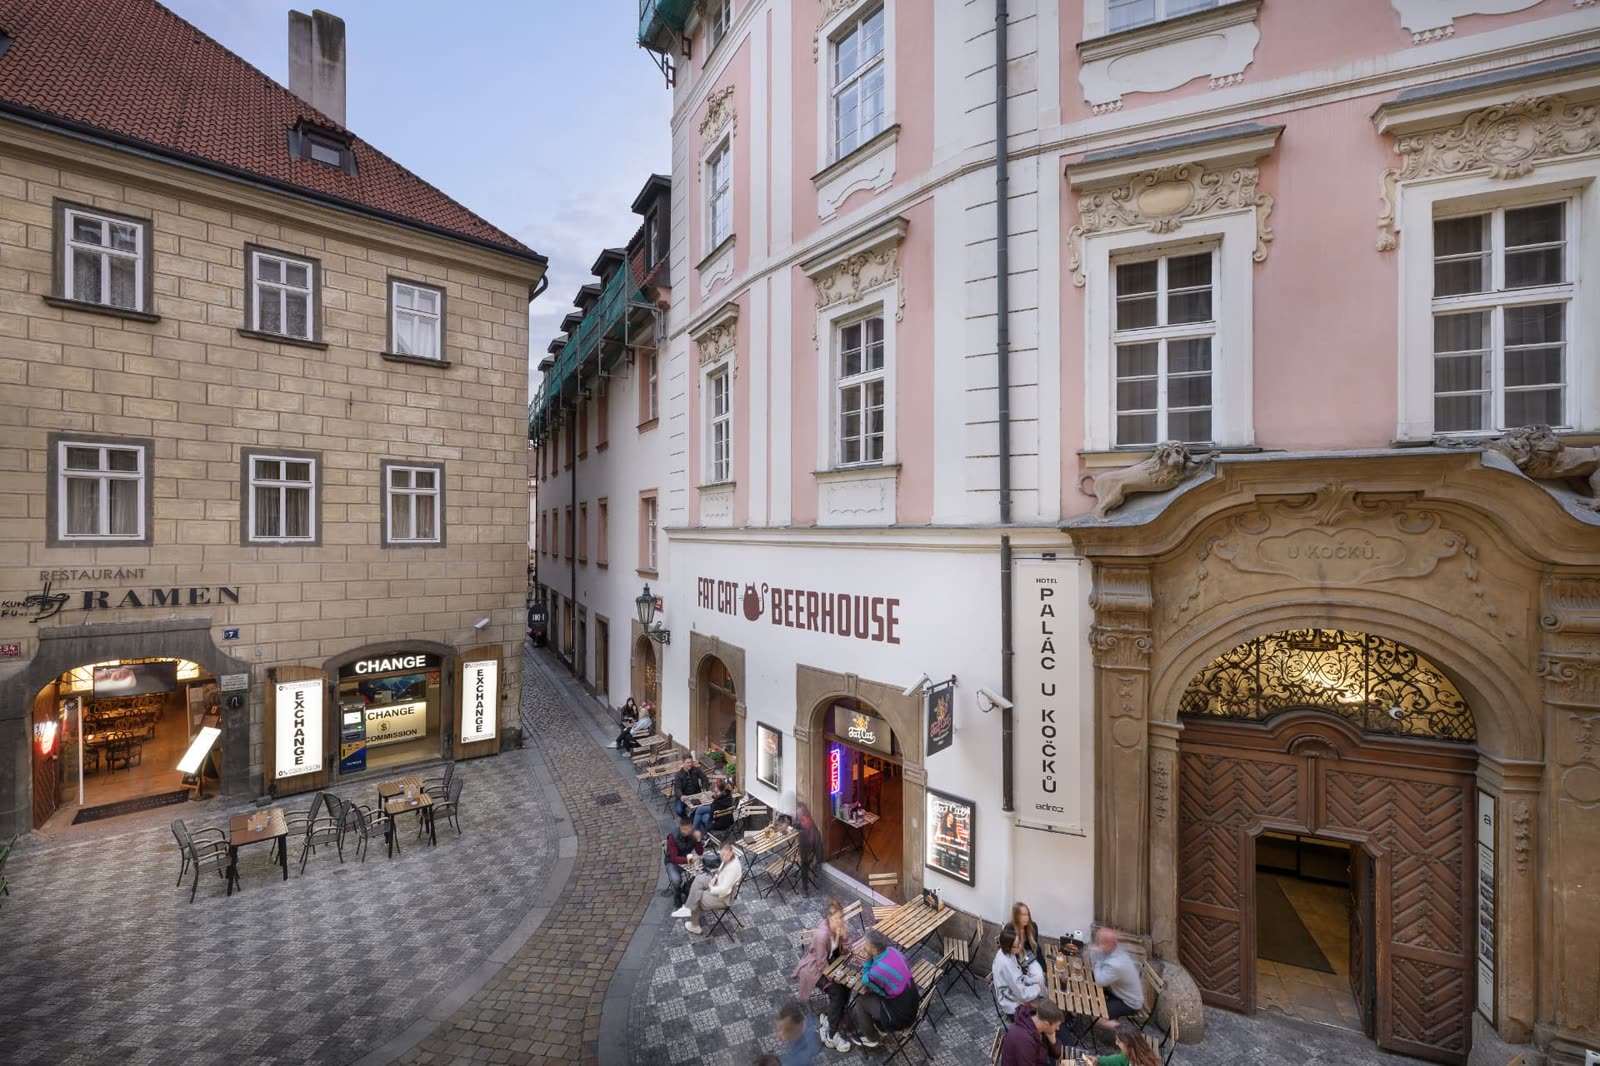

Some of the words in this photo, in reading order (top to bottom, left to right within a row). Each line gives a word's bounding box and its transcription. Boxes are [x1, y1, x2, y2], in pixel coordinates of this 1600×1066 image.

[1287, 545, 1299, 559] U
[40, 568, 146, 581] RESTAURANT
[1, 600, 36, 608] KUNG
[81, 586, 240, 609] RAMEN
[698, 577, 715, 610] FAT
[718, 580, 738, 616] CAT
[771, 587, 900, 644] BEERHOUSE
[1040, 588, 1056, 670] PALÁC
[355, 655, 426, 674] CHANGE
[476, 669, 484, 733] EXCHANGE
[1041, 683, 1056, 696] U
[293, 691, 305, 766] EXCHANGE
[1041, 709, 1057, 793] KOČKŮ
